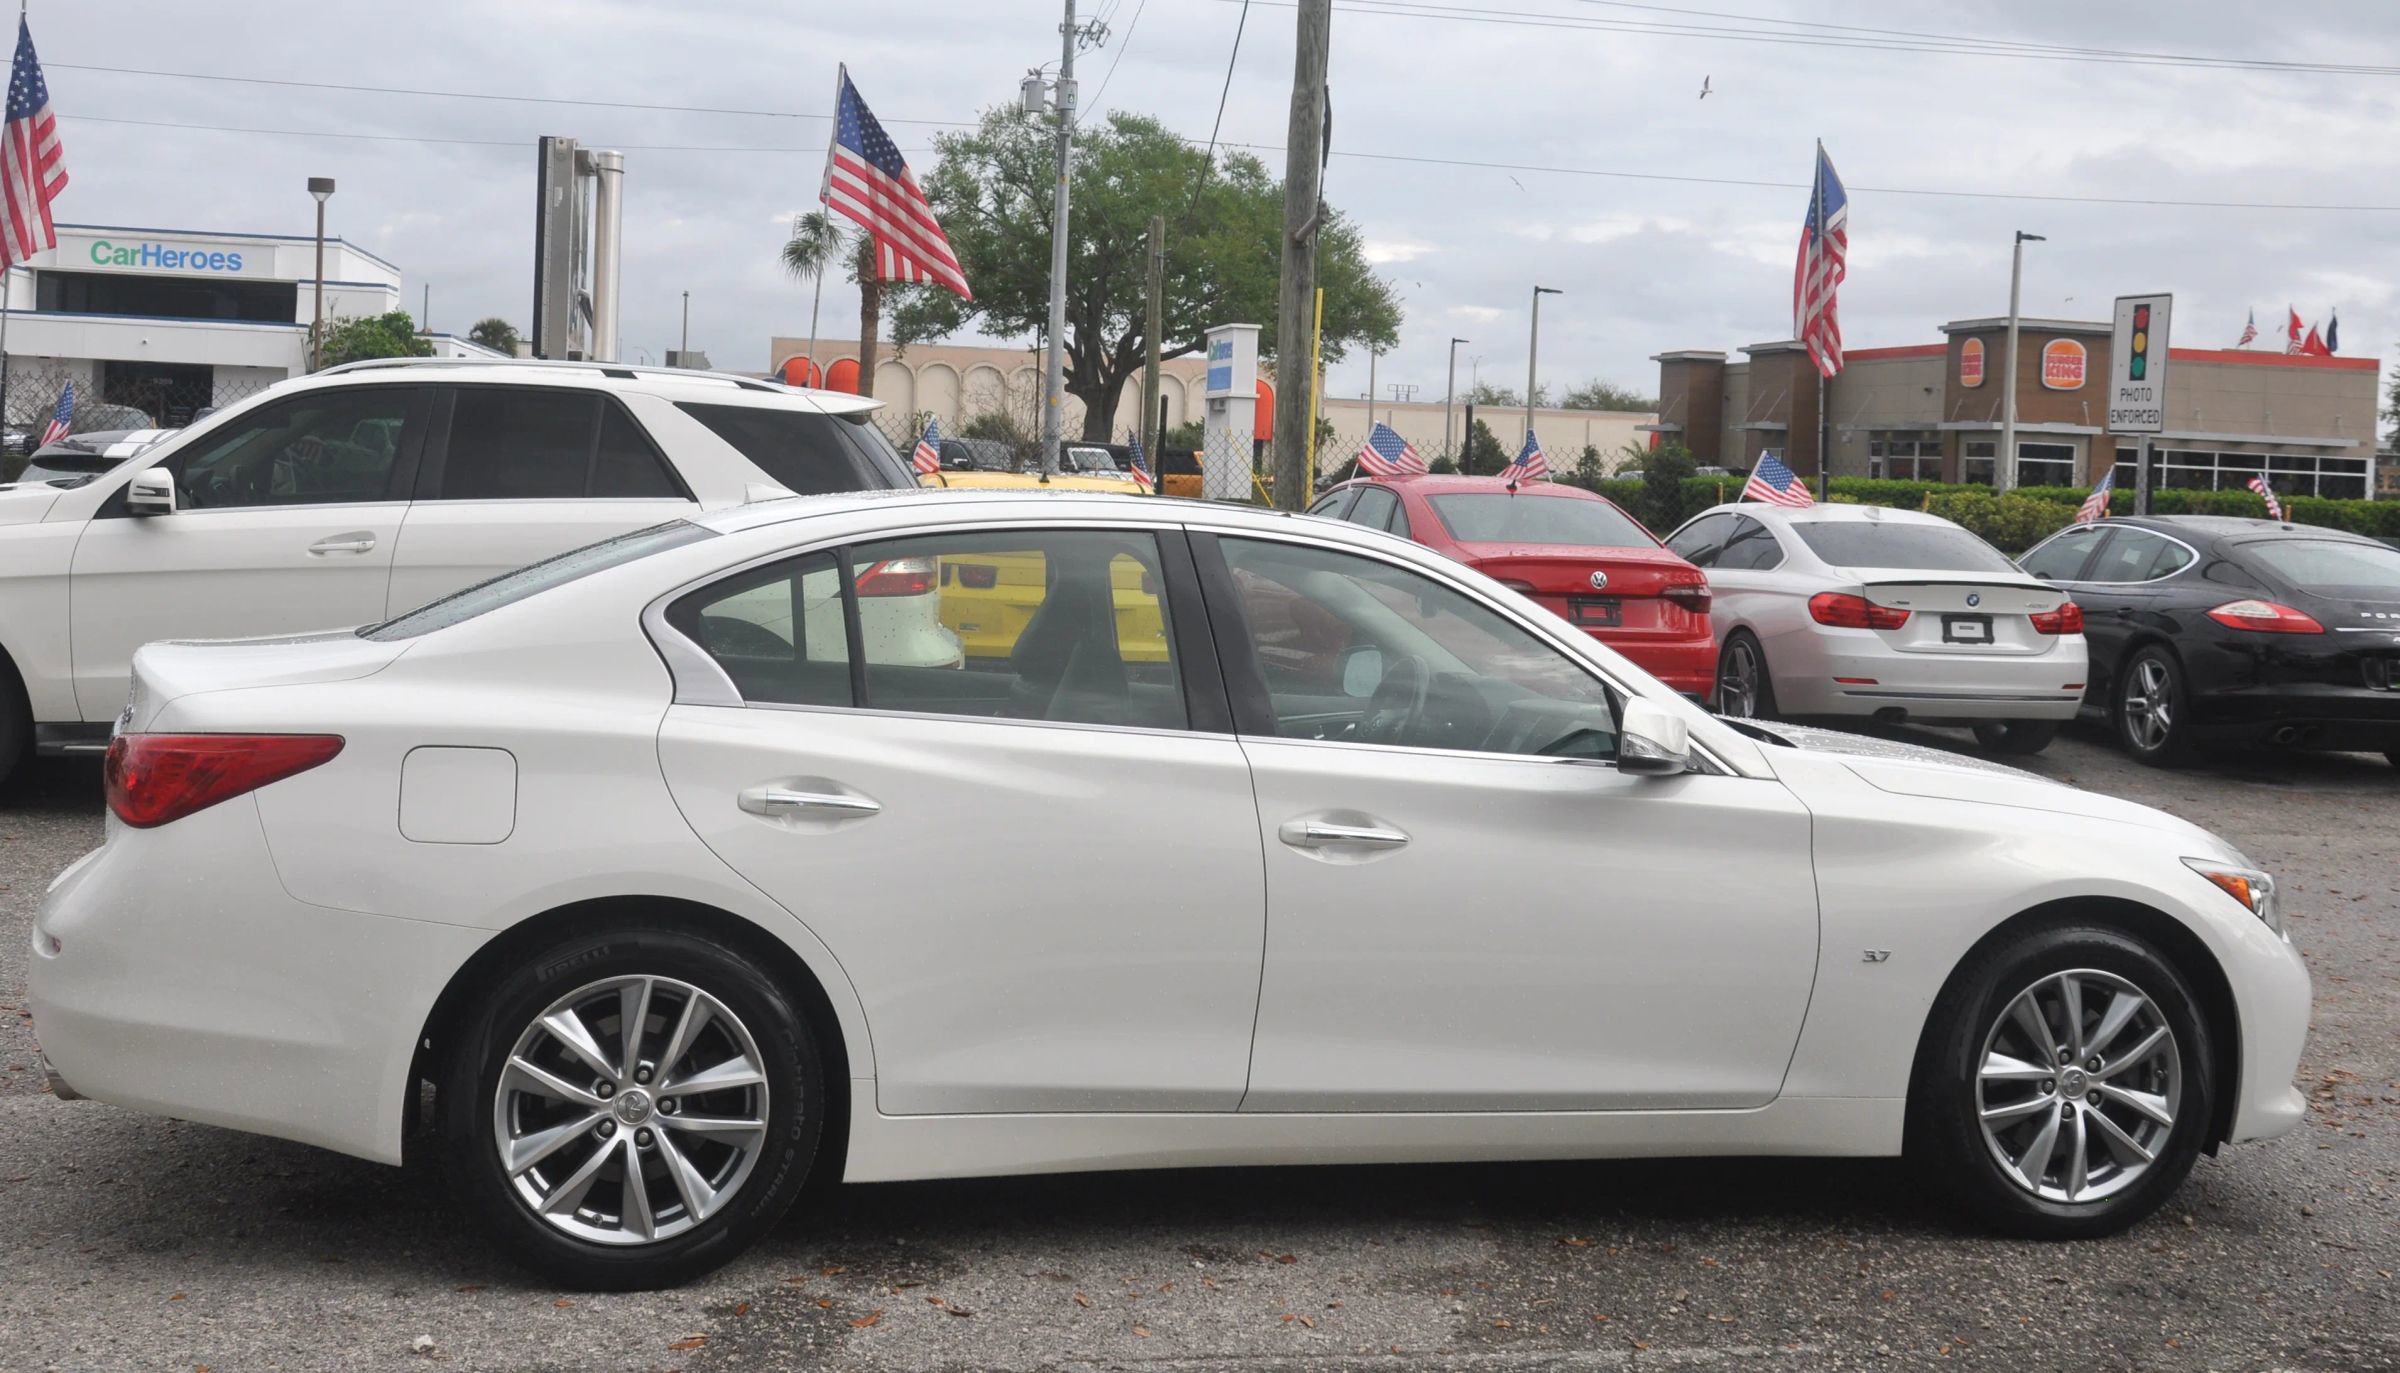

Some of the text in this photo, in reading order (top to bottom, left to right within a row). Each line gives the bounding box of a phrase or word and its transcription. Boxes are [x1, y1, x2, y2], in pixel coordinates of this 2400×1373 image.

[90, 240, 242, 271] CarHeroes
[2046, 363, 2082, 379] KING
[2120, 387, 2152, 402] PHOTO
[2111, 409, 2160, 424] ENFORCED
